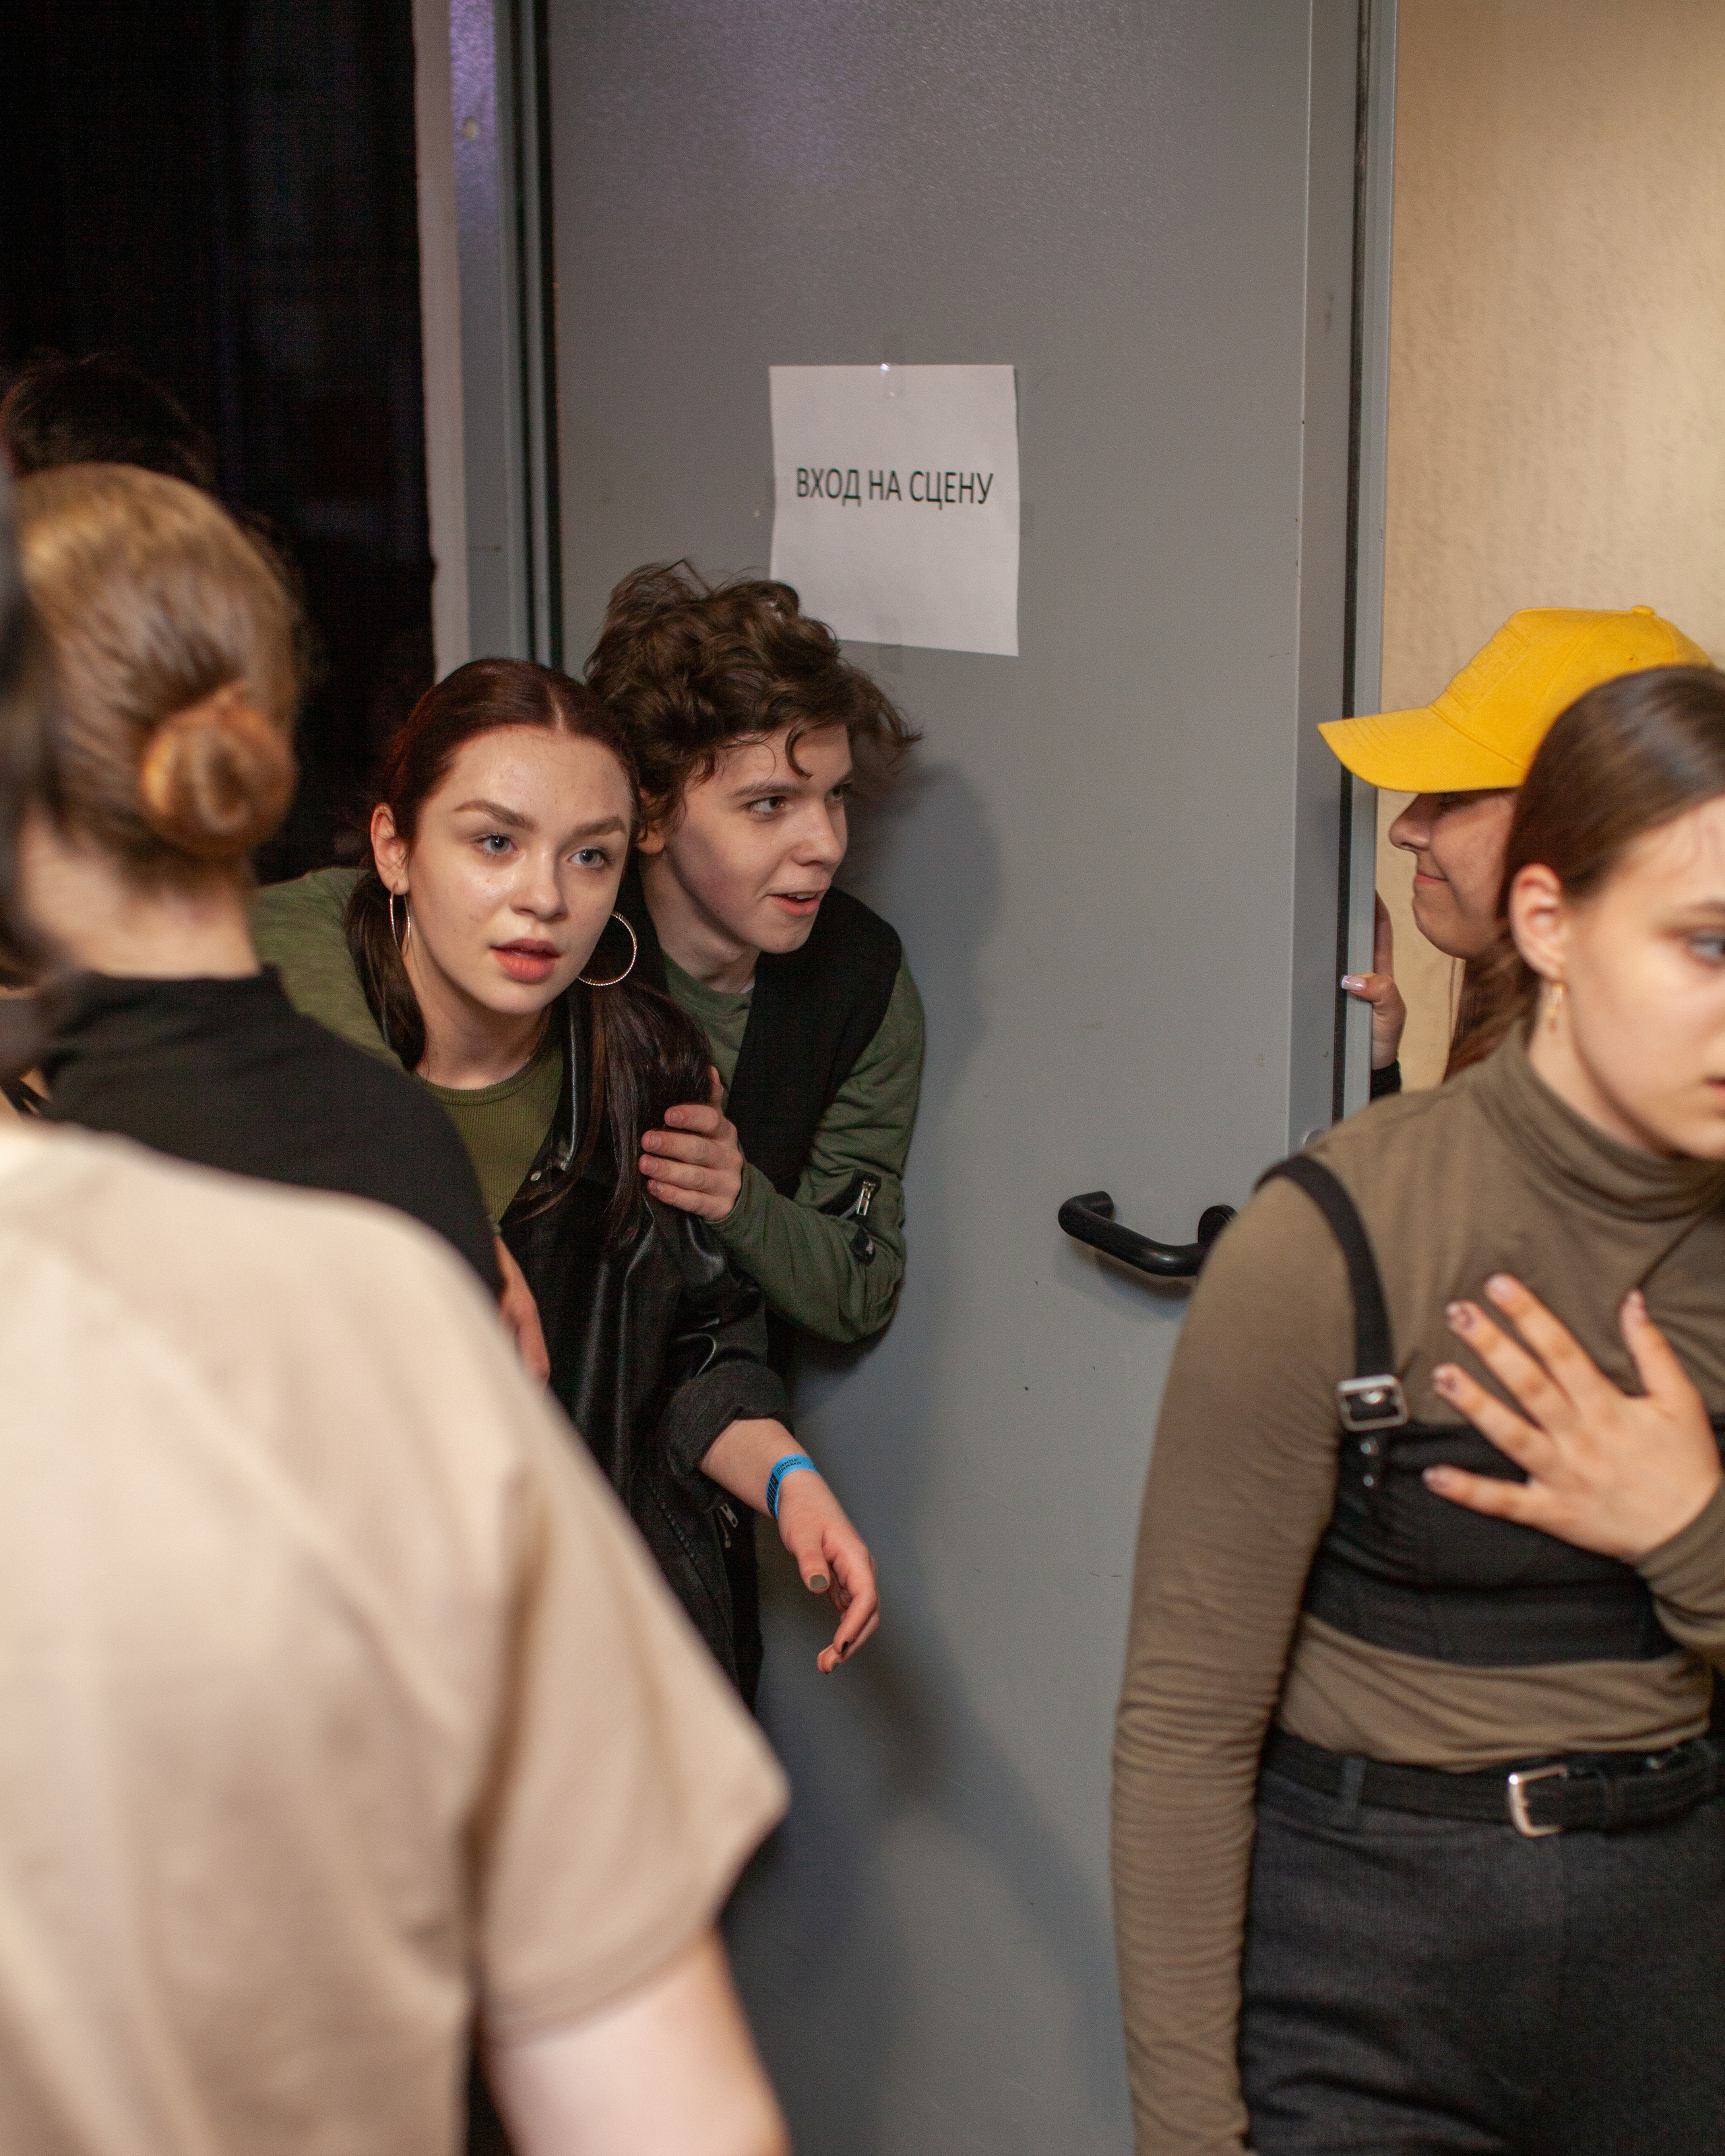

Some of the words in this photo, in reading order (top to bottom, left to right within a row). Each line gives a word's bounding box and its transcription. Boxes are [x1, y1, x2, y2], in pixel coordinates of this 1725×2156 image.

[796, 468, 861, 507] ВХОД
[869, 470, 902, 501] НА
[909, 470, 994, 510] СЦЕНУ
[776, 1458, 798, 1473] DANCE
[778, 1461, 802, 1476] CHAMP
